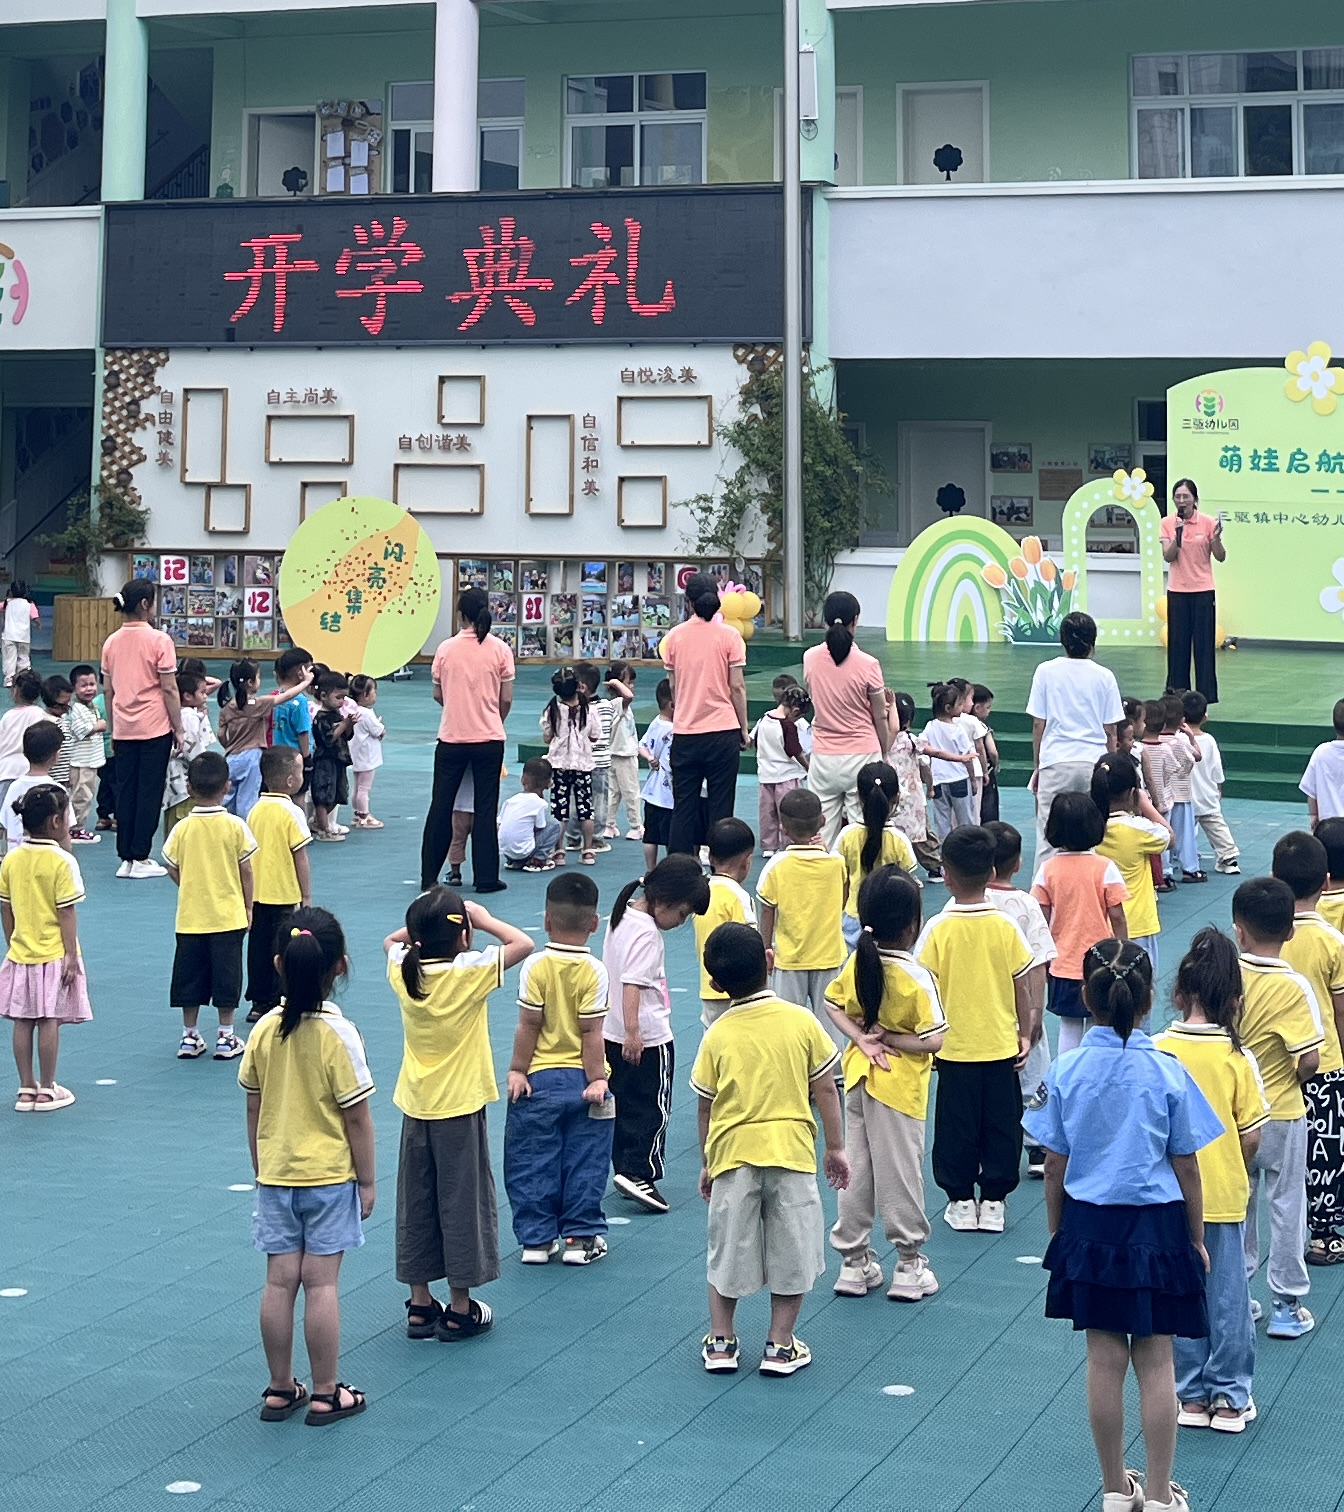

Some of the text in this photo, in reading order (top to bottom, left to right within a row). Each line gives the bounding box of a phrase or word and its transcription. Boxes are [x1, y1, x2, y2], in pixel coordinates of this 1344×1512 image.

[224, 216, 676, 334] 开学典礼
[156, 389, 174, 467] 自由健美
[267, 387, 338, 405] 自主尚美
[398, 433, 472, 451] 自创谐美
[580, 413, 600, 497] 自信和美
